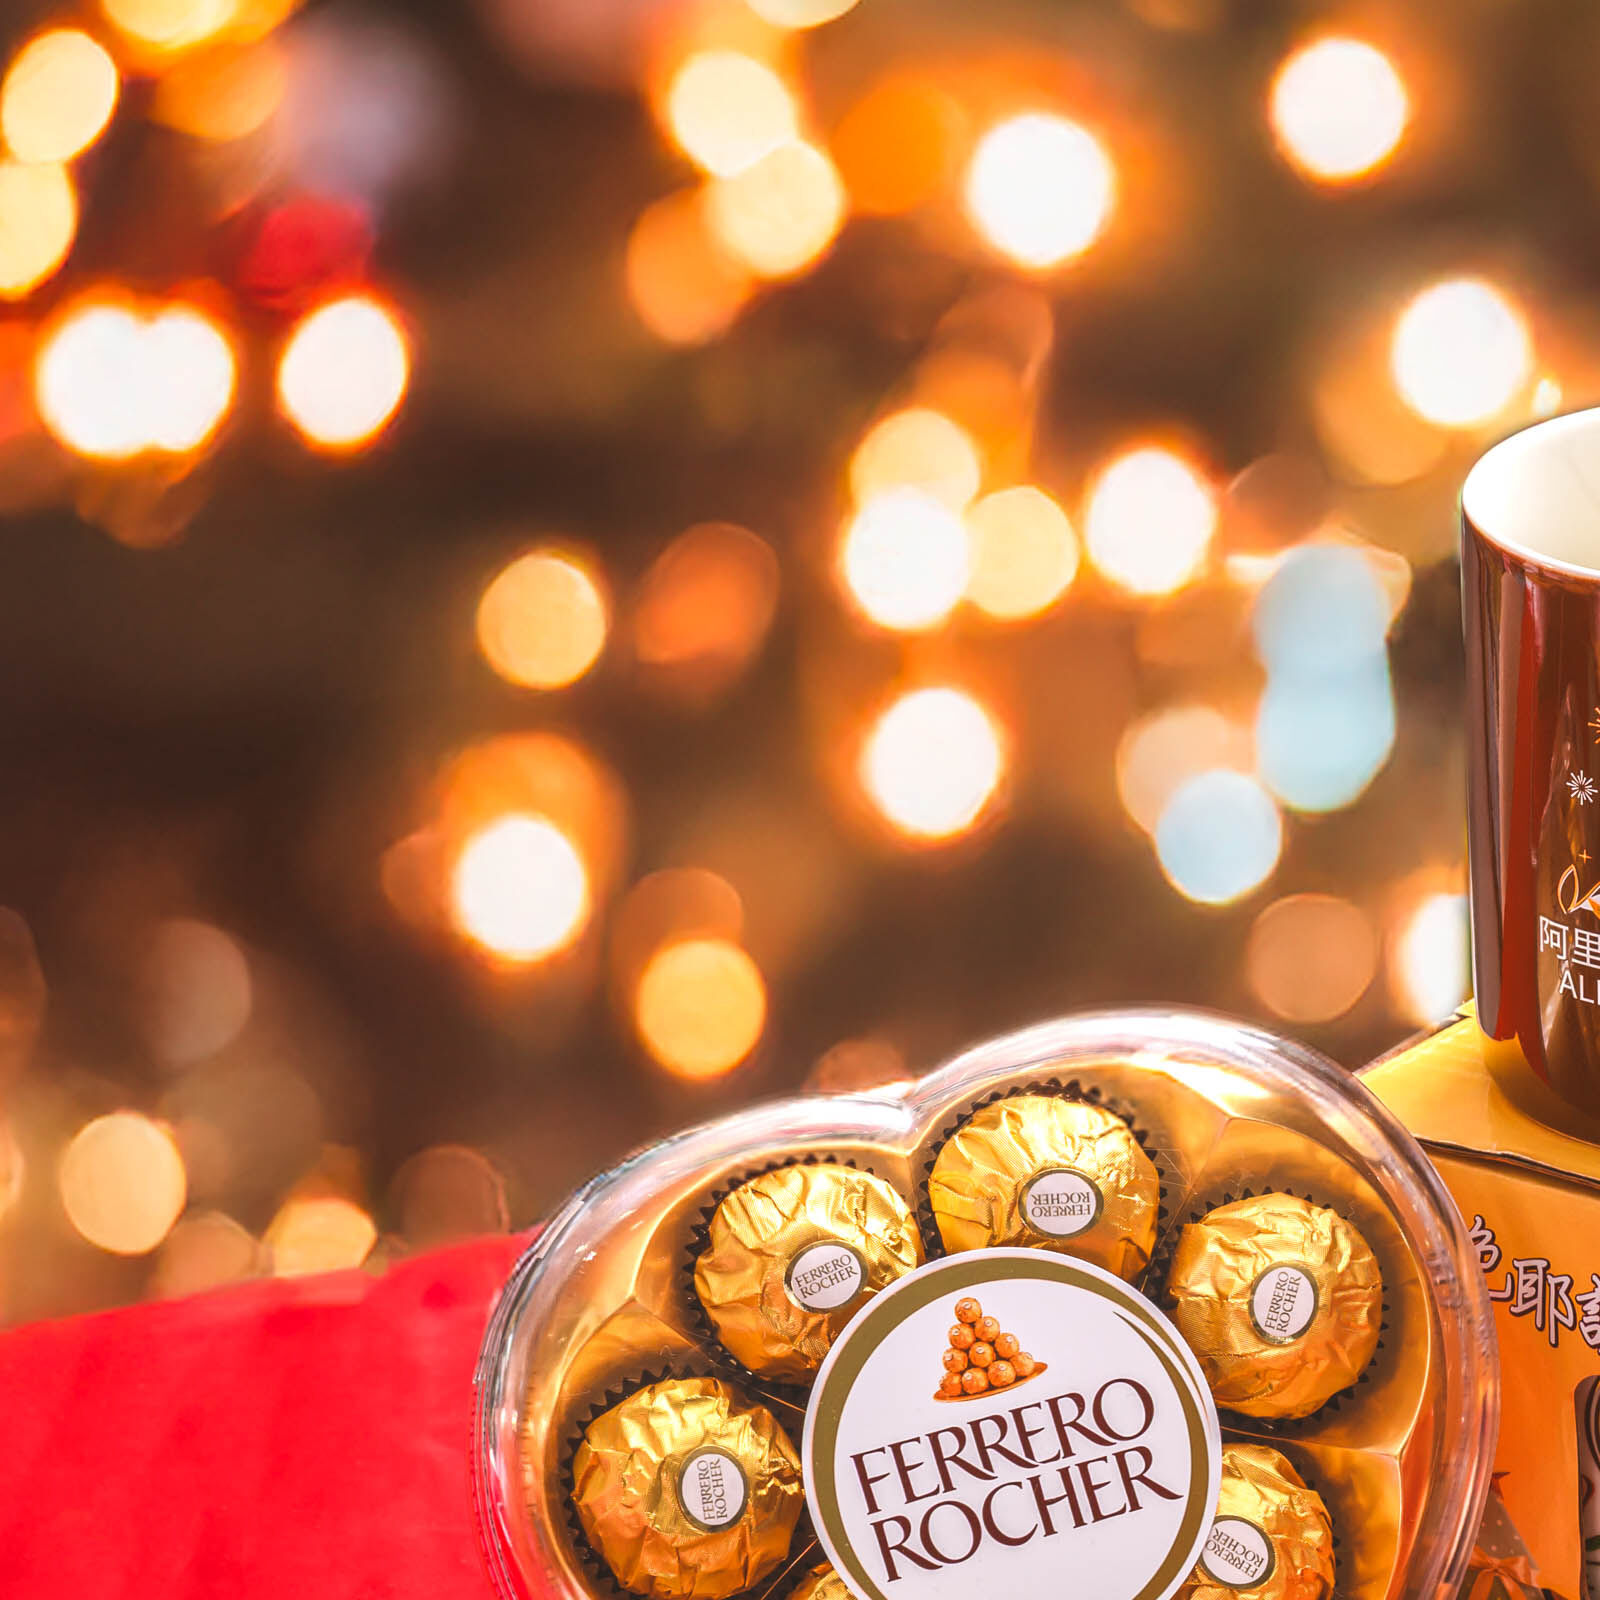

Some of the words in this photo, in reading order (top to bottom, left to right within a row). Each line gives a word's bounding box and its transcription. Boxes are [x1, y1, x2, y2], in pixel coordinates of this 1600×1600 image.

[1031, 1191, 1091, 1206] ROCHER
[1031, 1203, 1091, 1218] FERRERO
[794, 1253, 852, 1288] FERRERO
[799, 1265, 858, 1300] ROCHER
[1264, 1271, 1290, 1331] FERRERO
[1276, 1276, 1302, 1334] ROCHER
[850, 1378, 1154, 1515] FERRERO
[697, 1459, 715, 1521] FERRERO
[709, 1457, 728, 1520] ROCHER
[870, 1445, 1184, 1582] ROCHER
[1205, 1539, 1259, 1579] FERRERO
[1213, 1528, 1265, 1566] ROCHER
